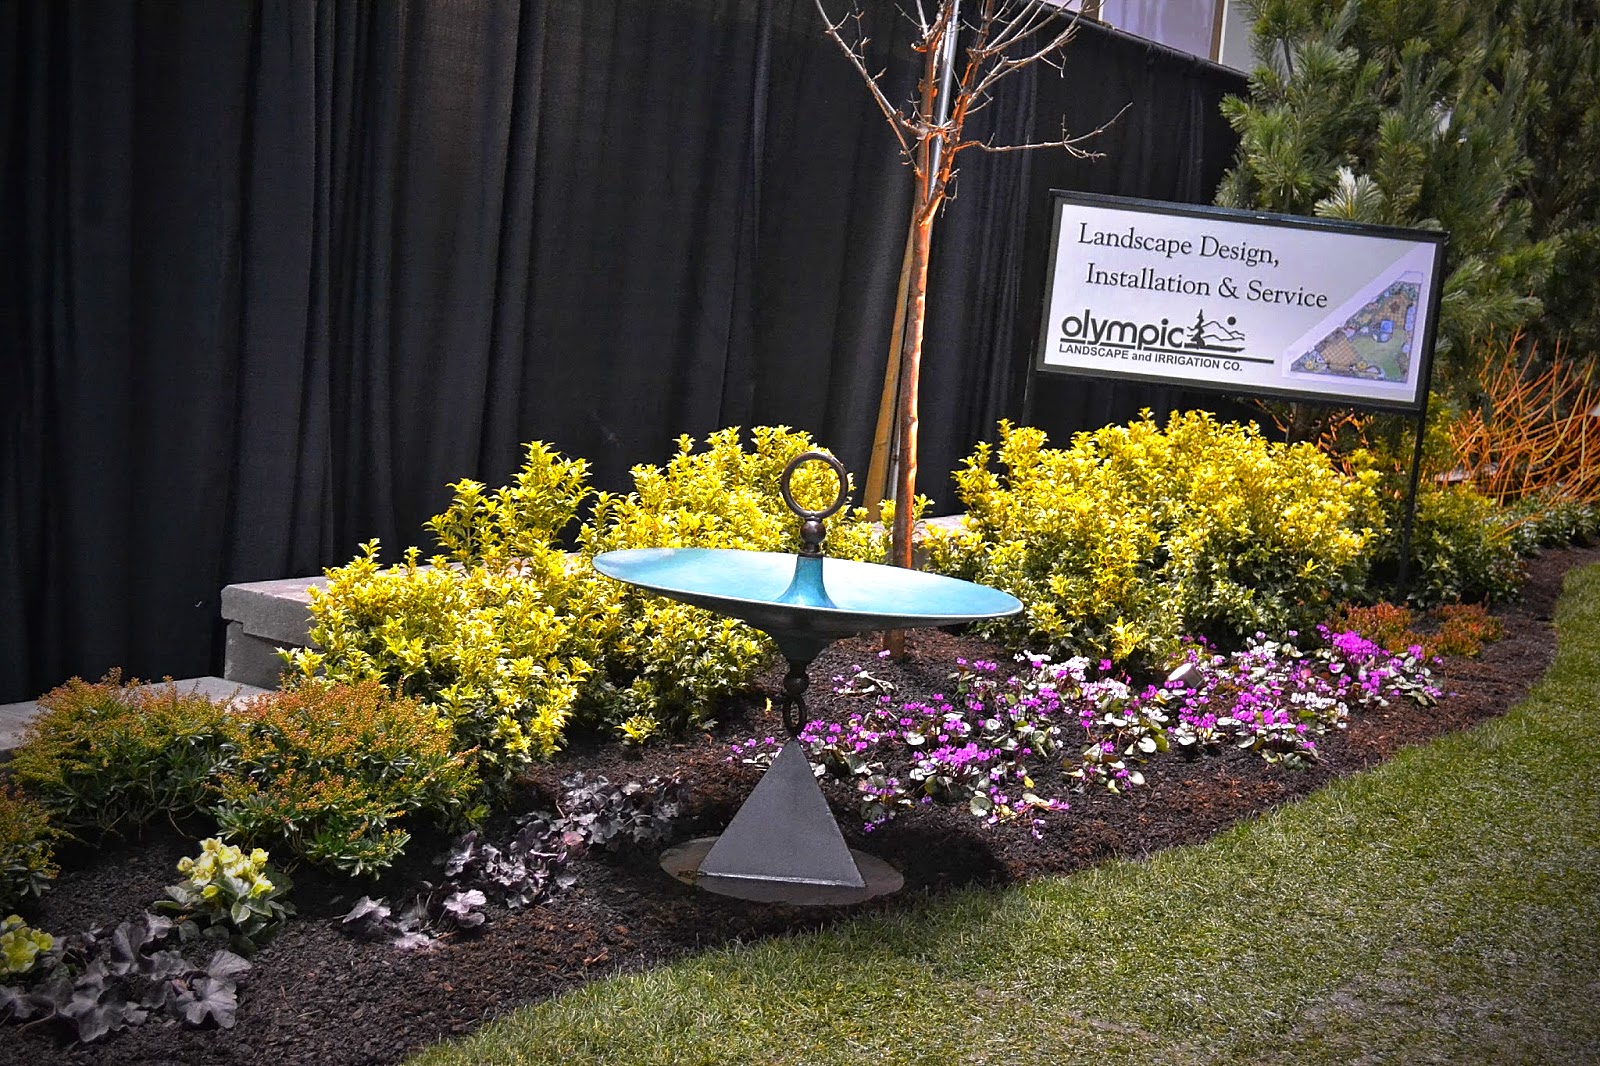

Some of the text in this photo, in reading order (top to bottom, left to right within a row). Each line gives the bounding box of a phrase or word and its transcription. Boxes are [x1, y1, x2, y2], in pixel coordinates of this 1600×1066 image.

[1078, 222, 1279, 268] Landscape Design,
[1085, 262, 1328, 308] Installation & Service
[1061, 309, 1184, 350] olympic
[1059, 343, 1243, 372] LANDSCAPE and IRRIGATION CO.
